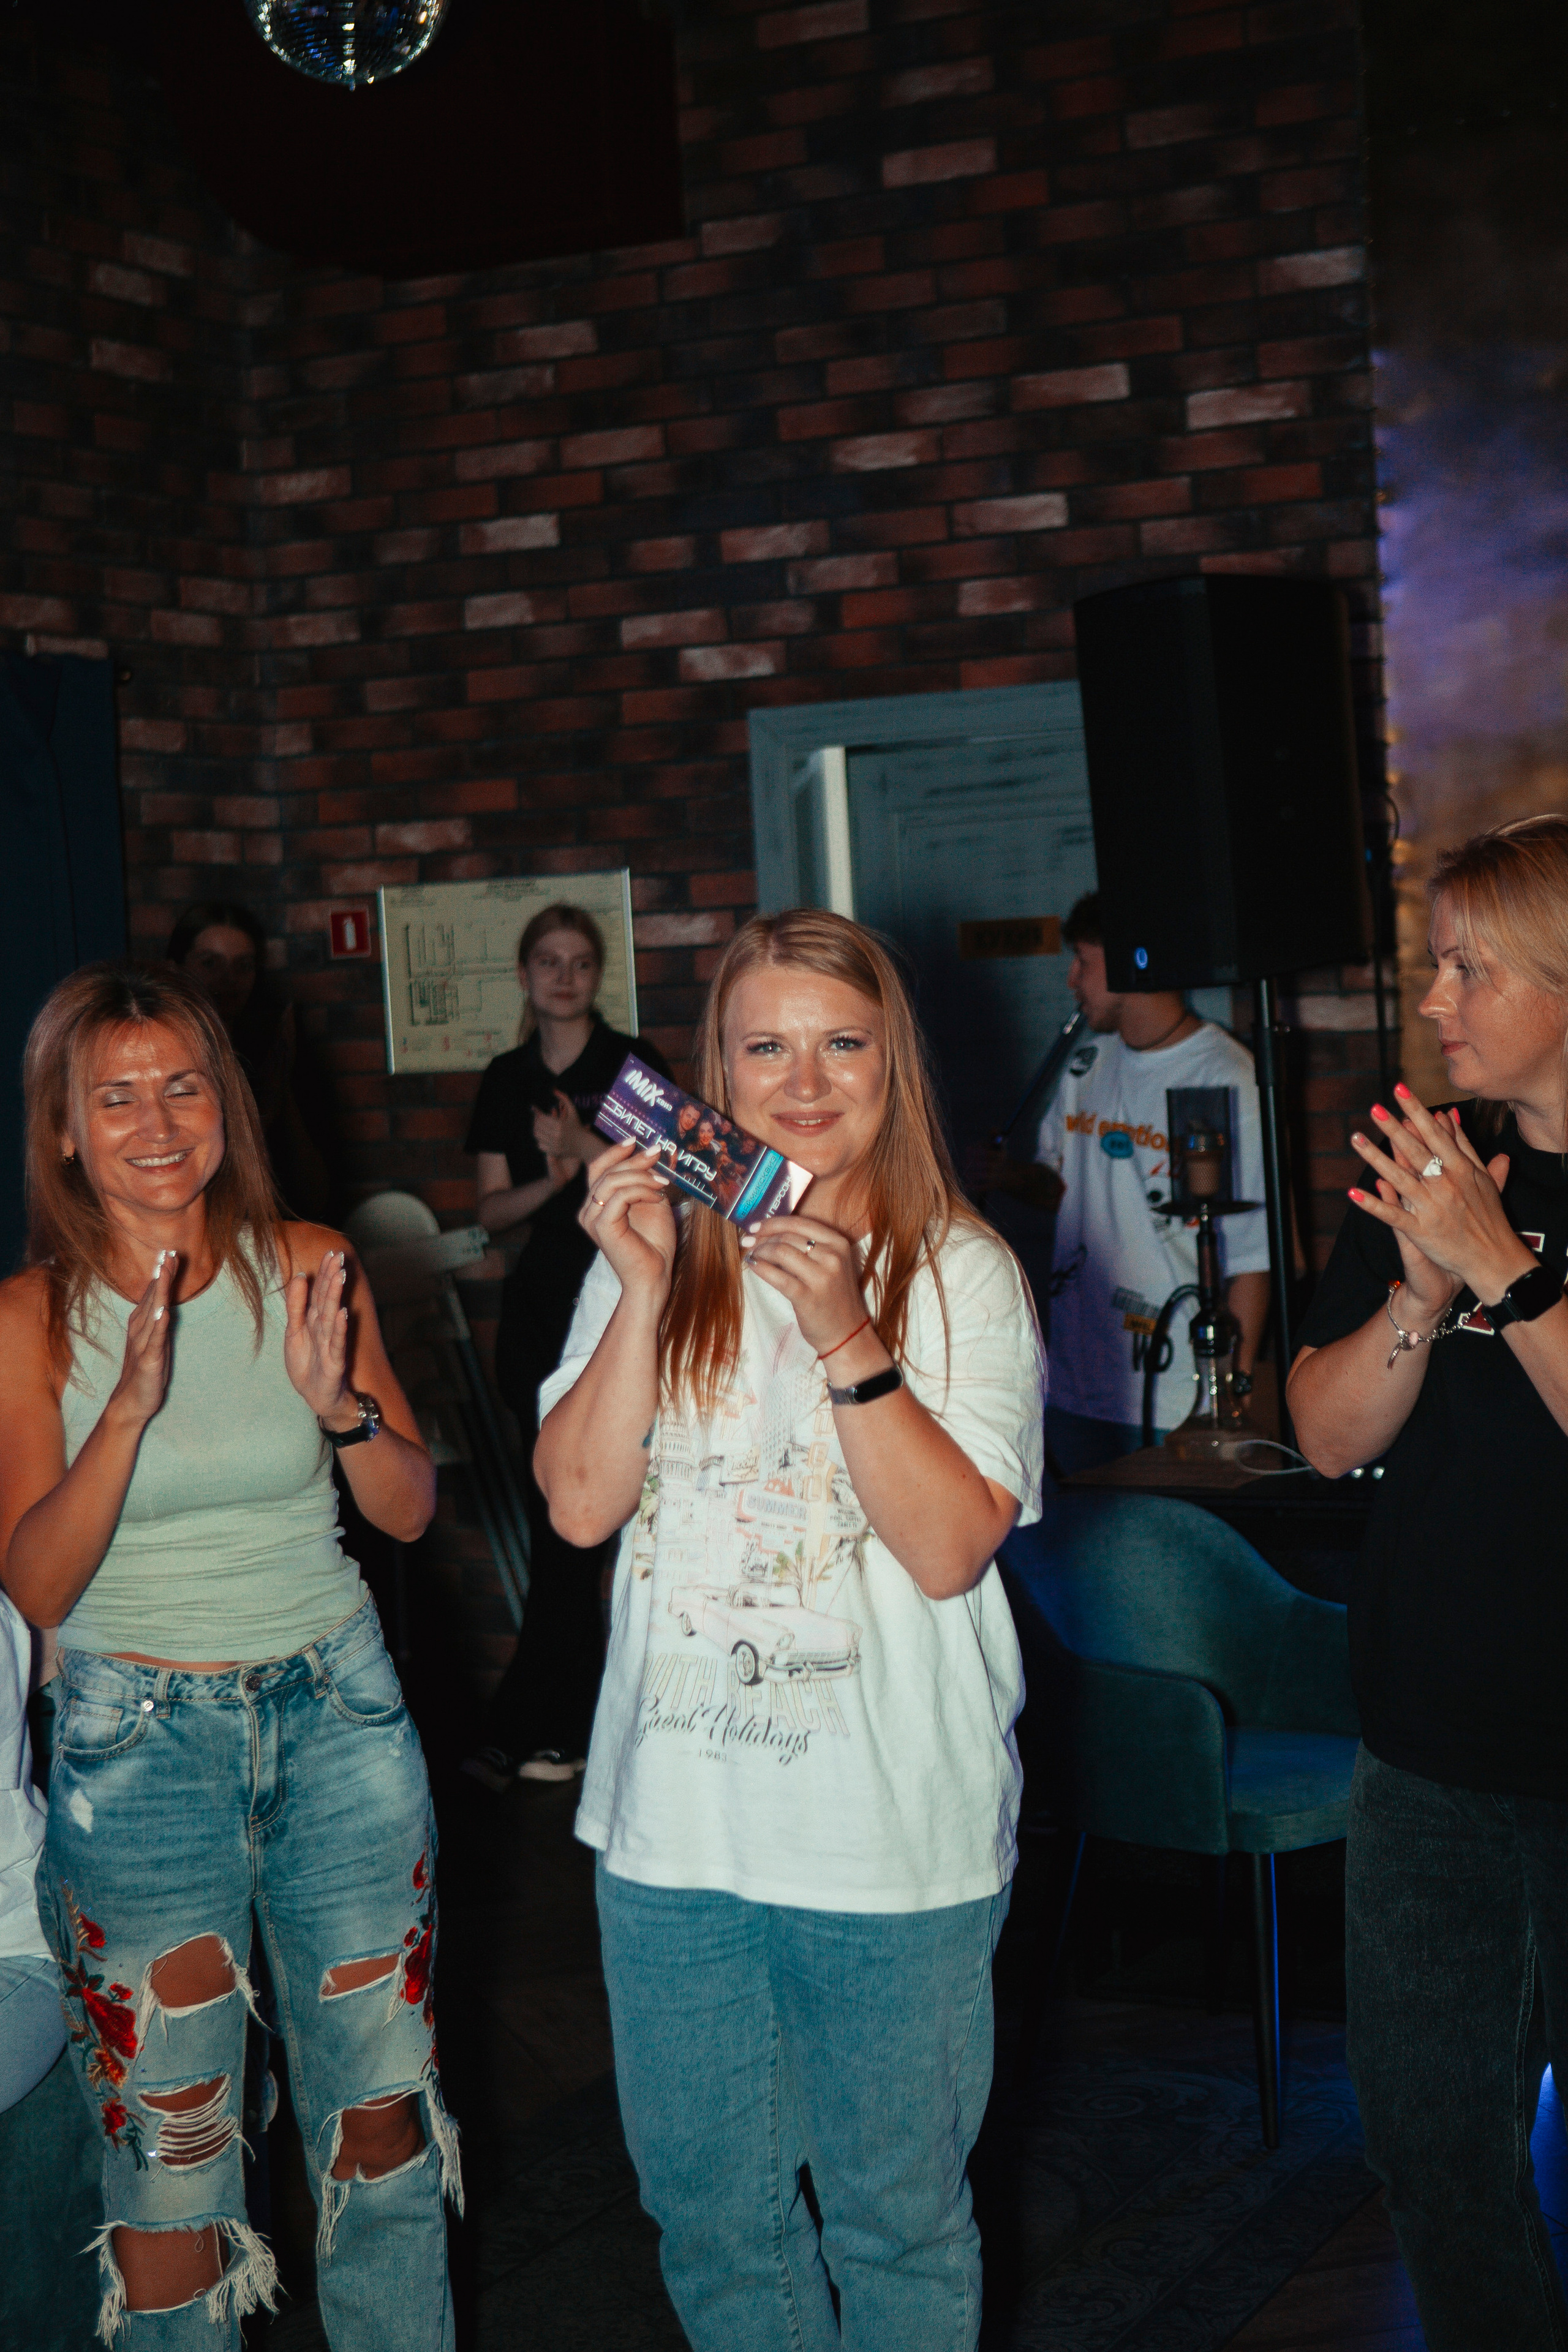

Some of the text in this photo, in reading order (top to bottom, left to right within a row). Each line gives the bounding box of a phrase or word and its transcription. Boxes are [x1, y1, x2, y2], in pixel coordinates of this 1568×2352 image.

[625, 1069, 664, 1107] IMIX
[656, 1097, 673, 1112] КВИЗ
[612, 1104, 717, 1182] БИЛЕТ НА ИГРУ
[769, 1175, 793, 1215] ПЕРСОН
[746, 1493, 808, 1521] SUMMER
[701, 1703, 811, 1766] Holidays
[698, 1749, 728, 1762] 1983
